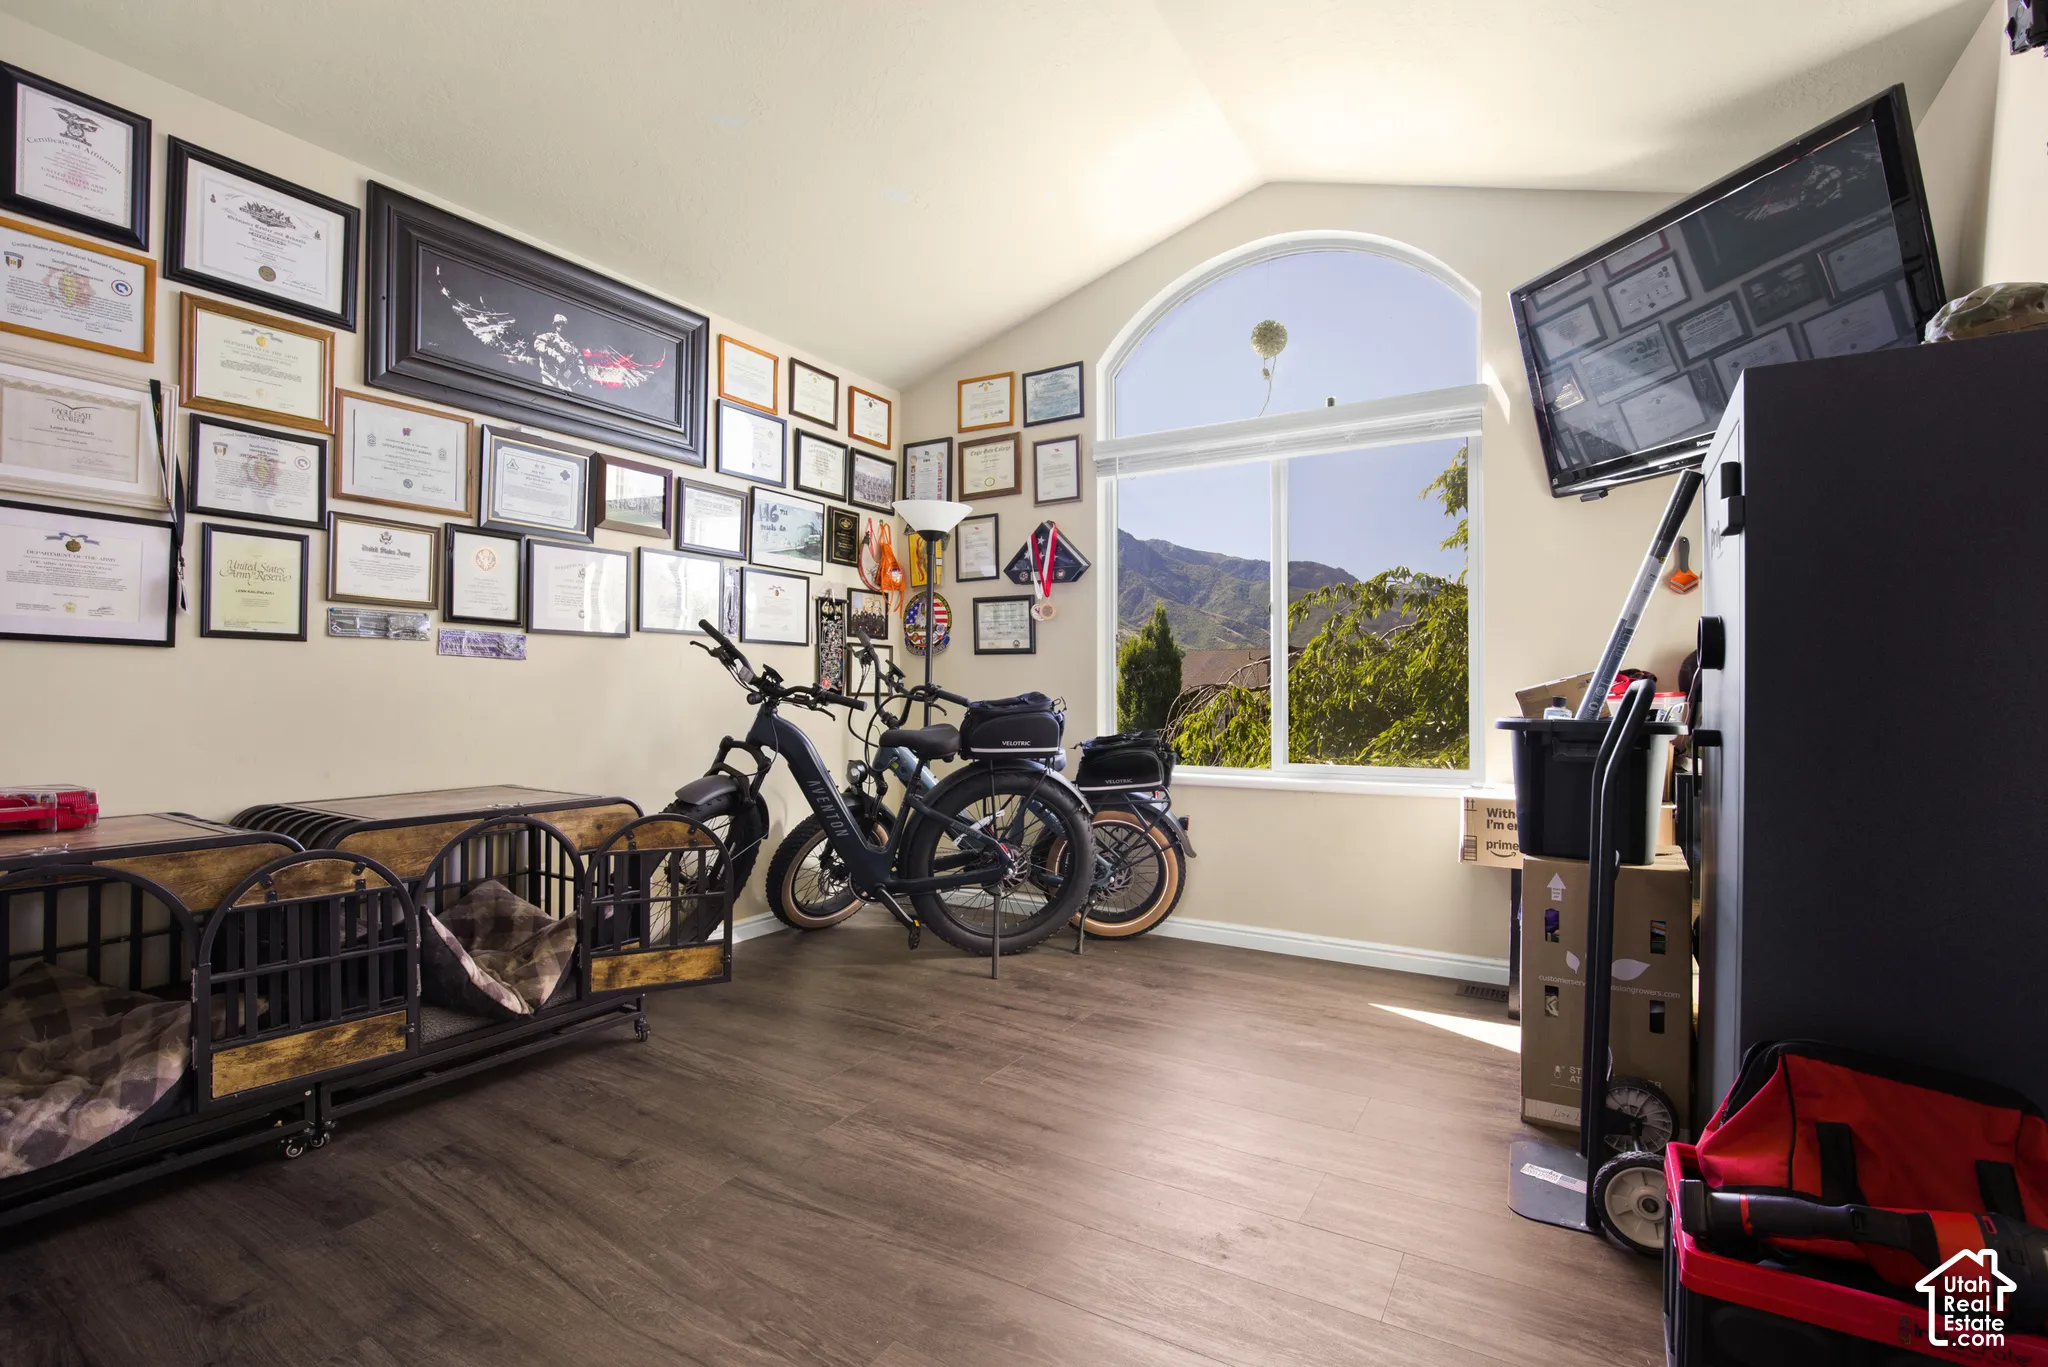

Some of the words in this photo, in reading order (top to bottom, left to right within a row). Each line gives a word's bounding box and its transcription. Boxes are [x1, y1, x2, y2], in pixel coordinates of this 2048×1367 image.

[51, 407, 73, 417] EAGLE
[73, 410, 92, 421] GATE
[26, 549, 72, 559] DEPARTMENT
[227, 559, 258, 572] United
[260, 562, 286, 575] States
[254, 570, 292, 582] Reserve
[806, 780, 850, 837] AVENTON
[1486, 807, 1517, 819] With
[1486, 839, 1520, 851] prime
